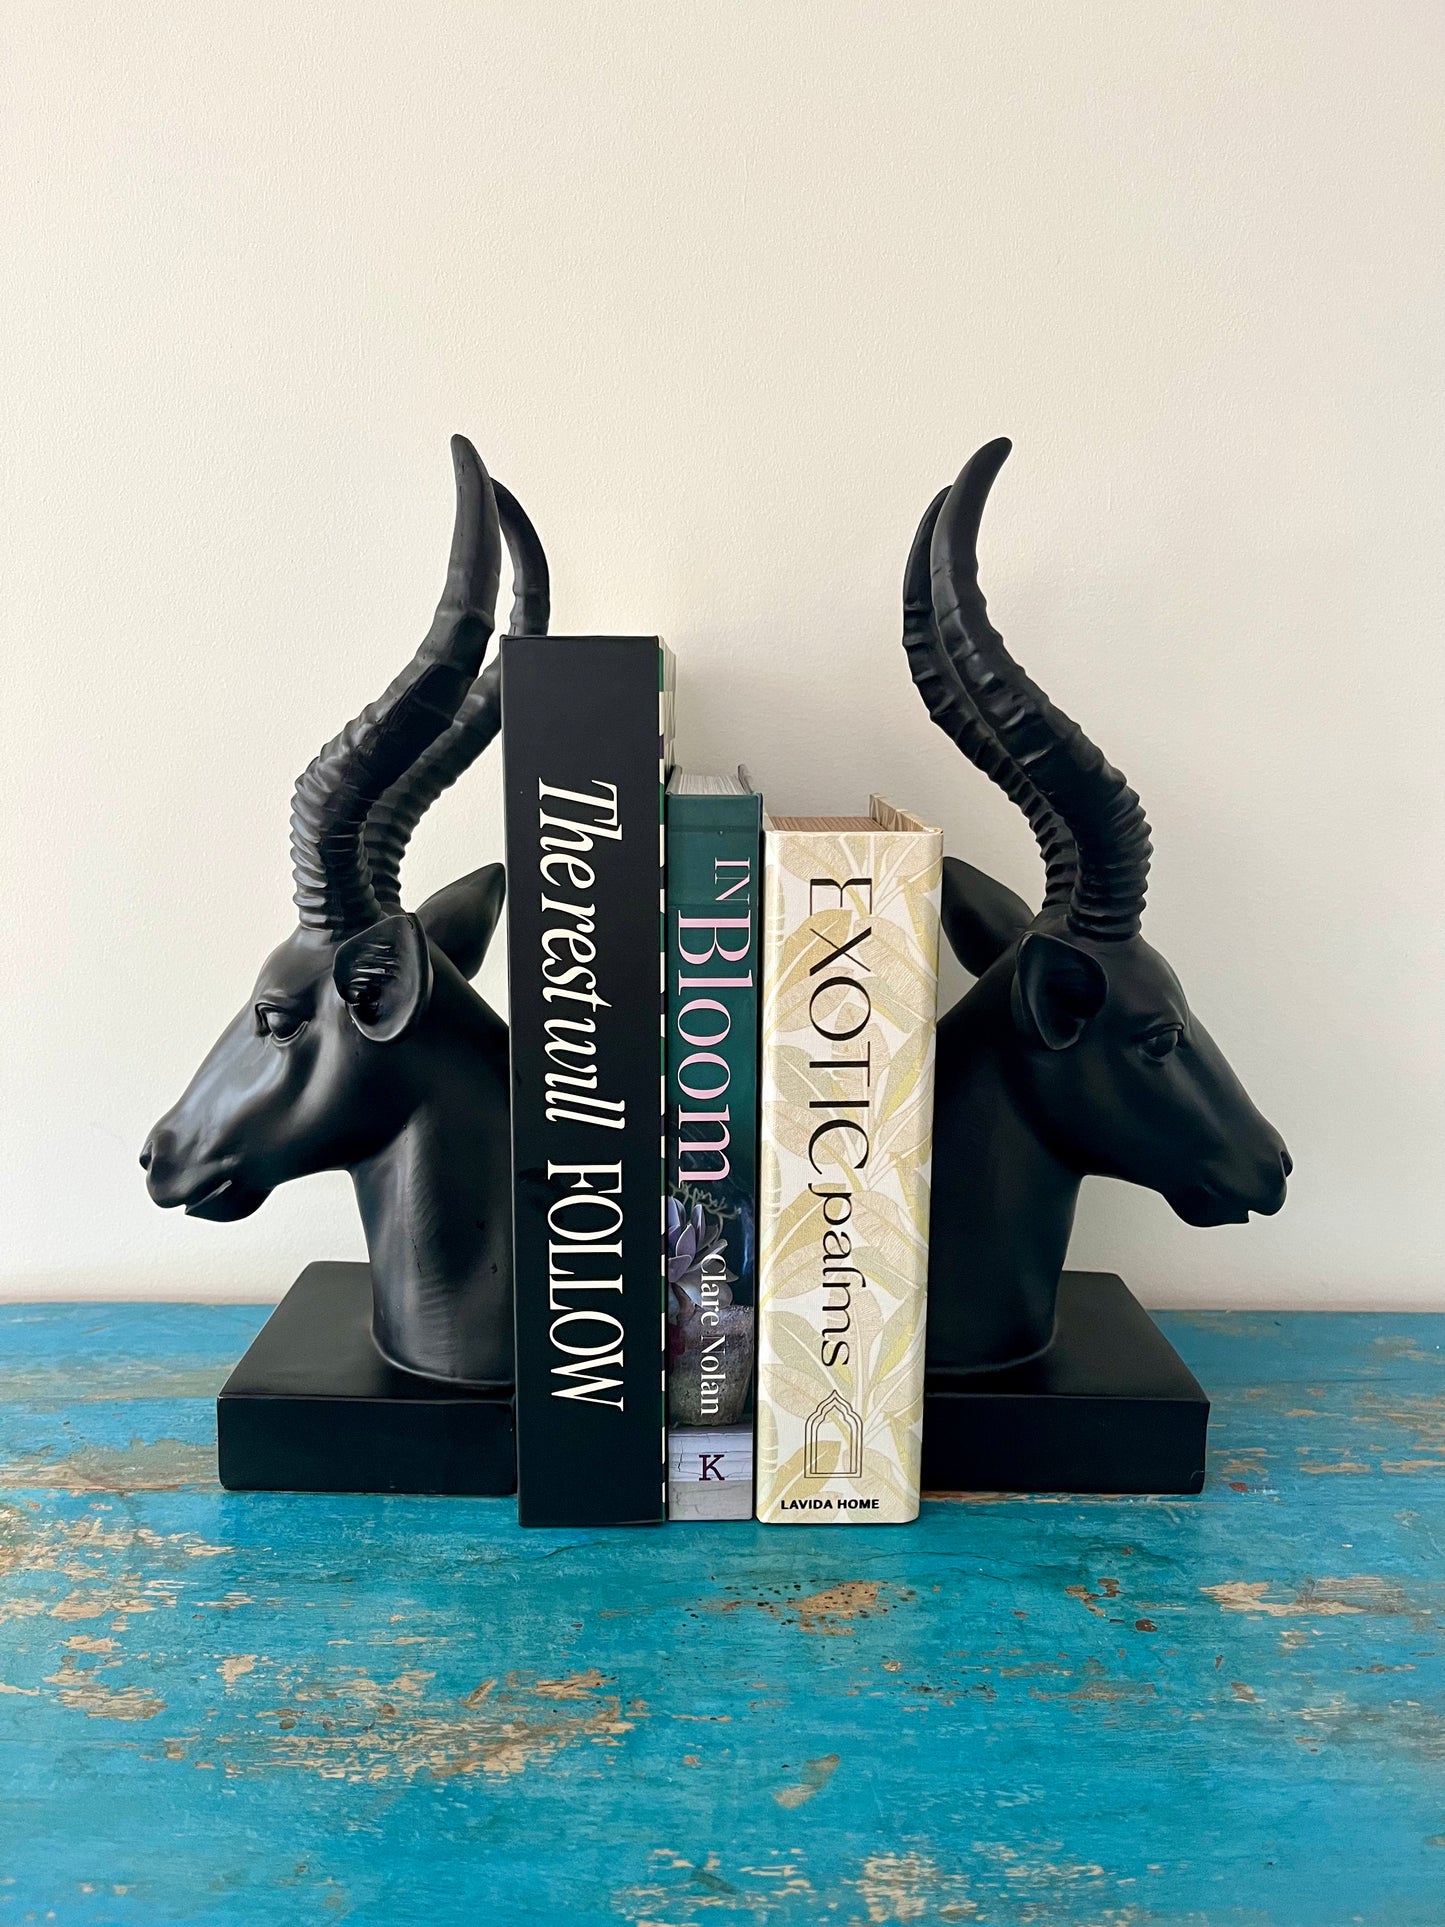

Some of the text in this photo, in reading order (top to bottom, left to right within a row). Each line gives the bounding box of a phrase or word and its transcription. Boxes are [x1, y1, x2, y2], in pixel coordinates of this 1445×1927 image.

[539, 777, 625, 1411] The rest will FOLLOW
[678, 858, 752, 1188] IN Bloom
[808, 878, 872, 1366] EXOTIC palms
[701, 1253, 726, 1414] Clare Nolan
[699, 1455, 725, 1481] K
[780, 1498, 880, 1510] LAVIDA HOME
